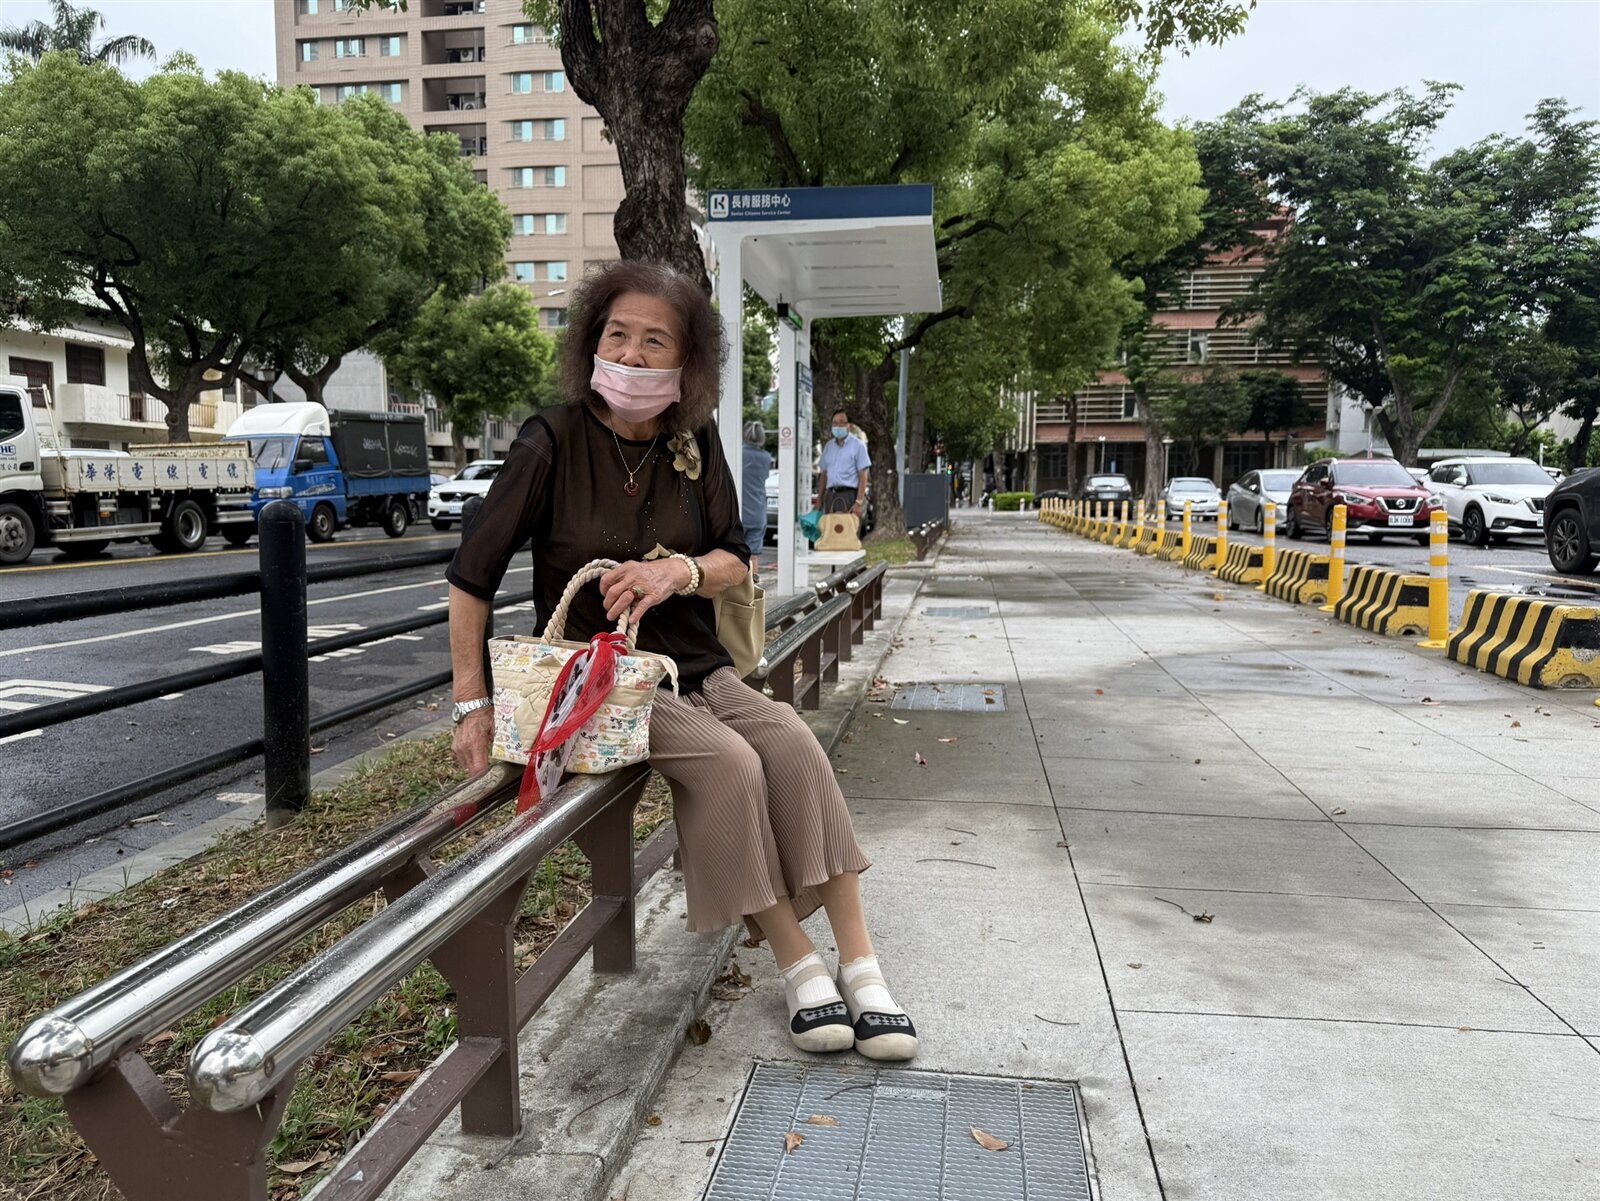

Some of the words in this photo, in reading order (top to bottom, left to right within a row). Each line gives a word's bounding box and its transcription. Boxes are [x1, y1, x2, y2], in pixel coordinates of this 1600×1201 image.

[732, 193, 791, 209] 長青服務中心
